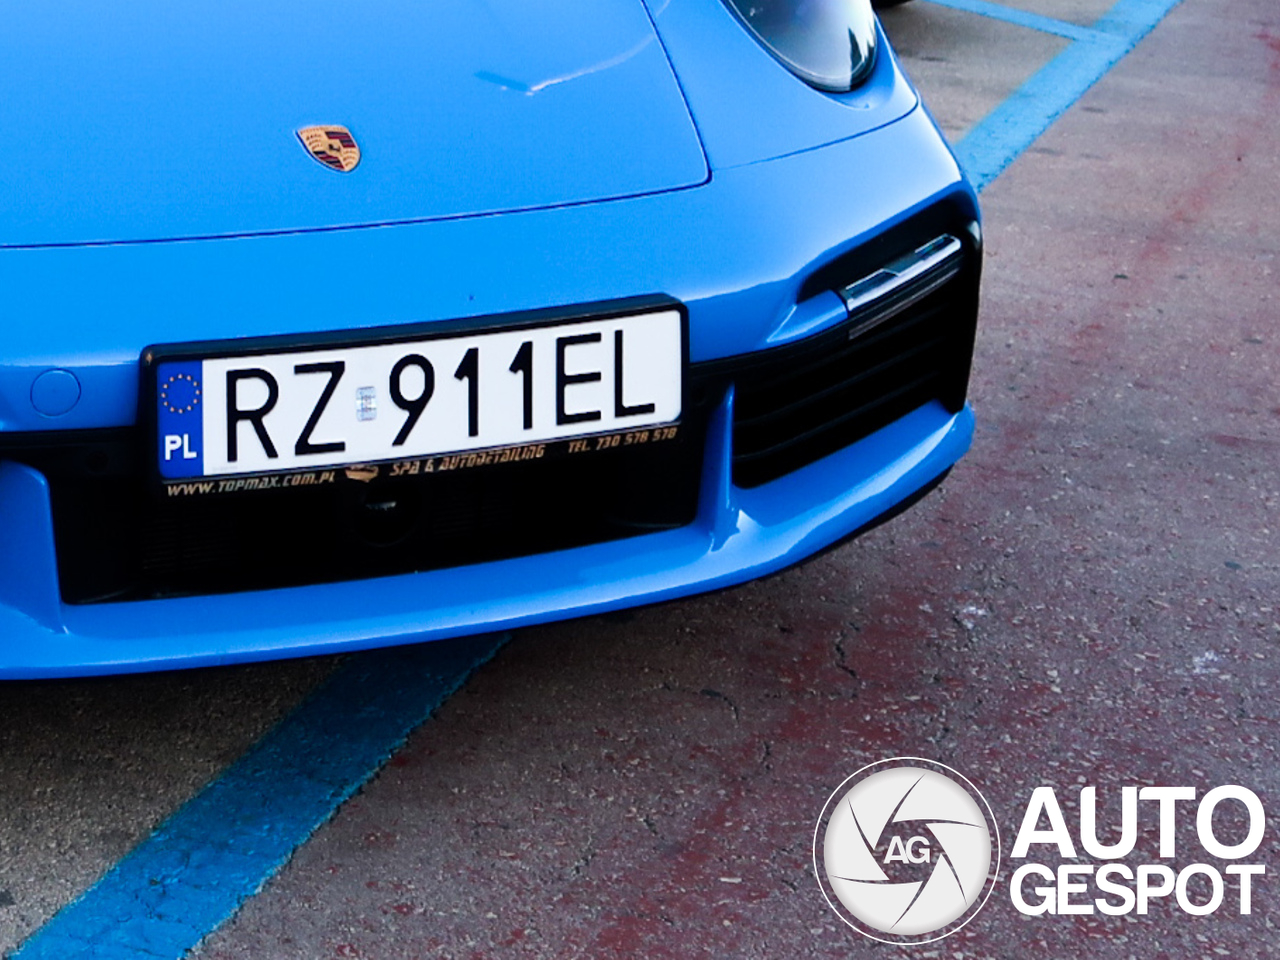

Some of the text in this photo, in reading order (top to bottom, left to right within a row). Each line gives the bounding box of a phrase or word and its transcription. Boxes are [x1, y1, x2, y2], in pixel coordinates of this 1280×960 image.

[226, 329, 656, 462] RZ 911EL
[164, 433, 198, 460] PL
[389, 461, 420, 476] SPA
[596, 435, 620, 451] 730
